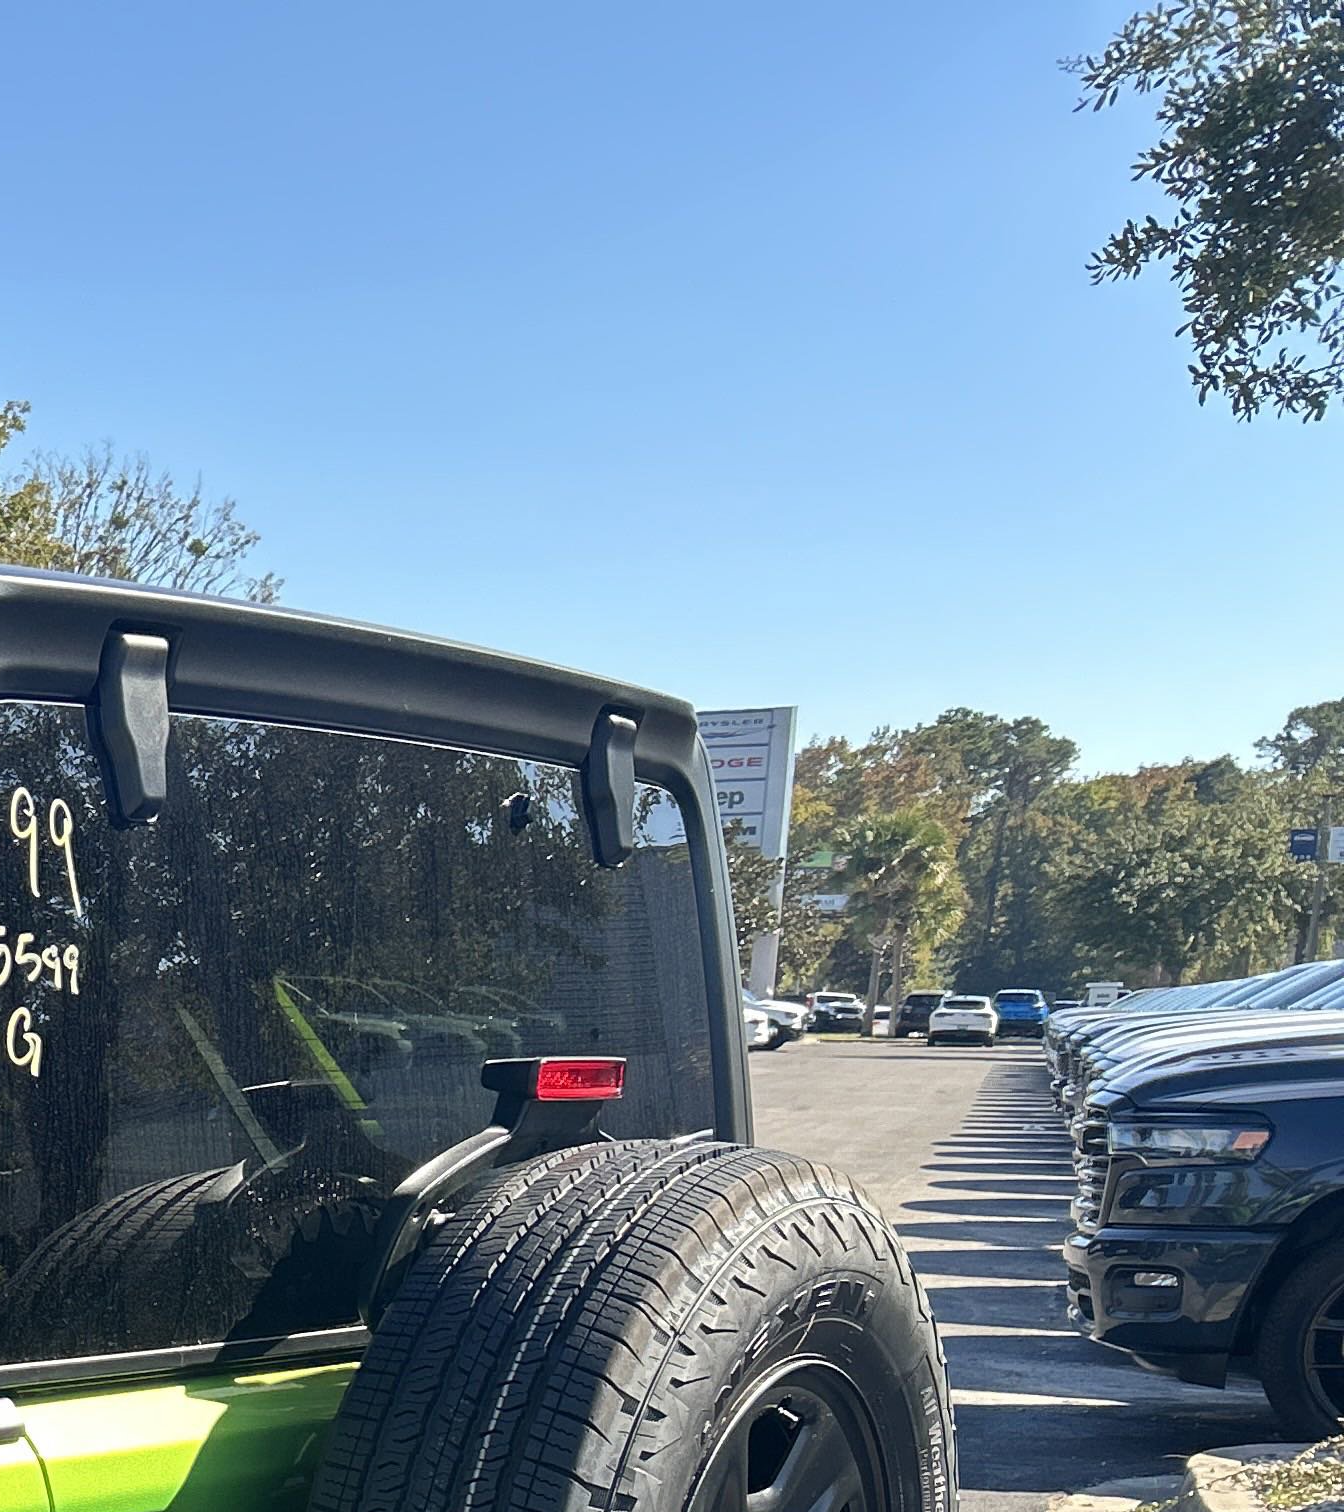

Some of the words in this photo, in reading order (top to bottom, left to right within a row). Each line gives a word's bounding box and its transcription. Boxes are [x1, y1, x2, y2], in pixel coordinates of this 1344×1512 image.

[698, 718, 765, 727] RYSLER
[712, 757, 764, 769] DGE
[716, 790, 745, 809] ep
[10, 786, 82, 918] 99
[6, 1006, 42, 1077] G
